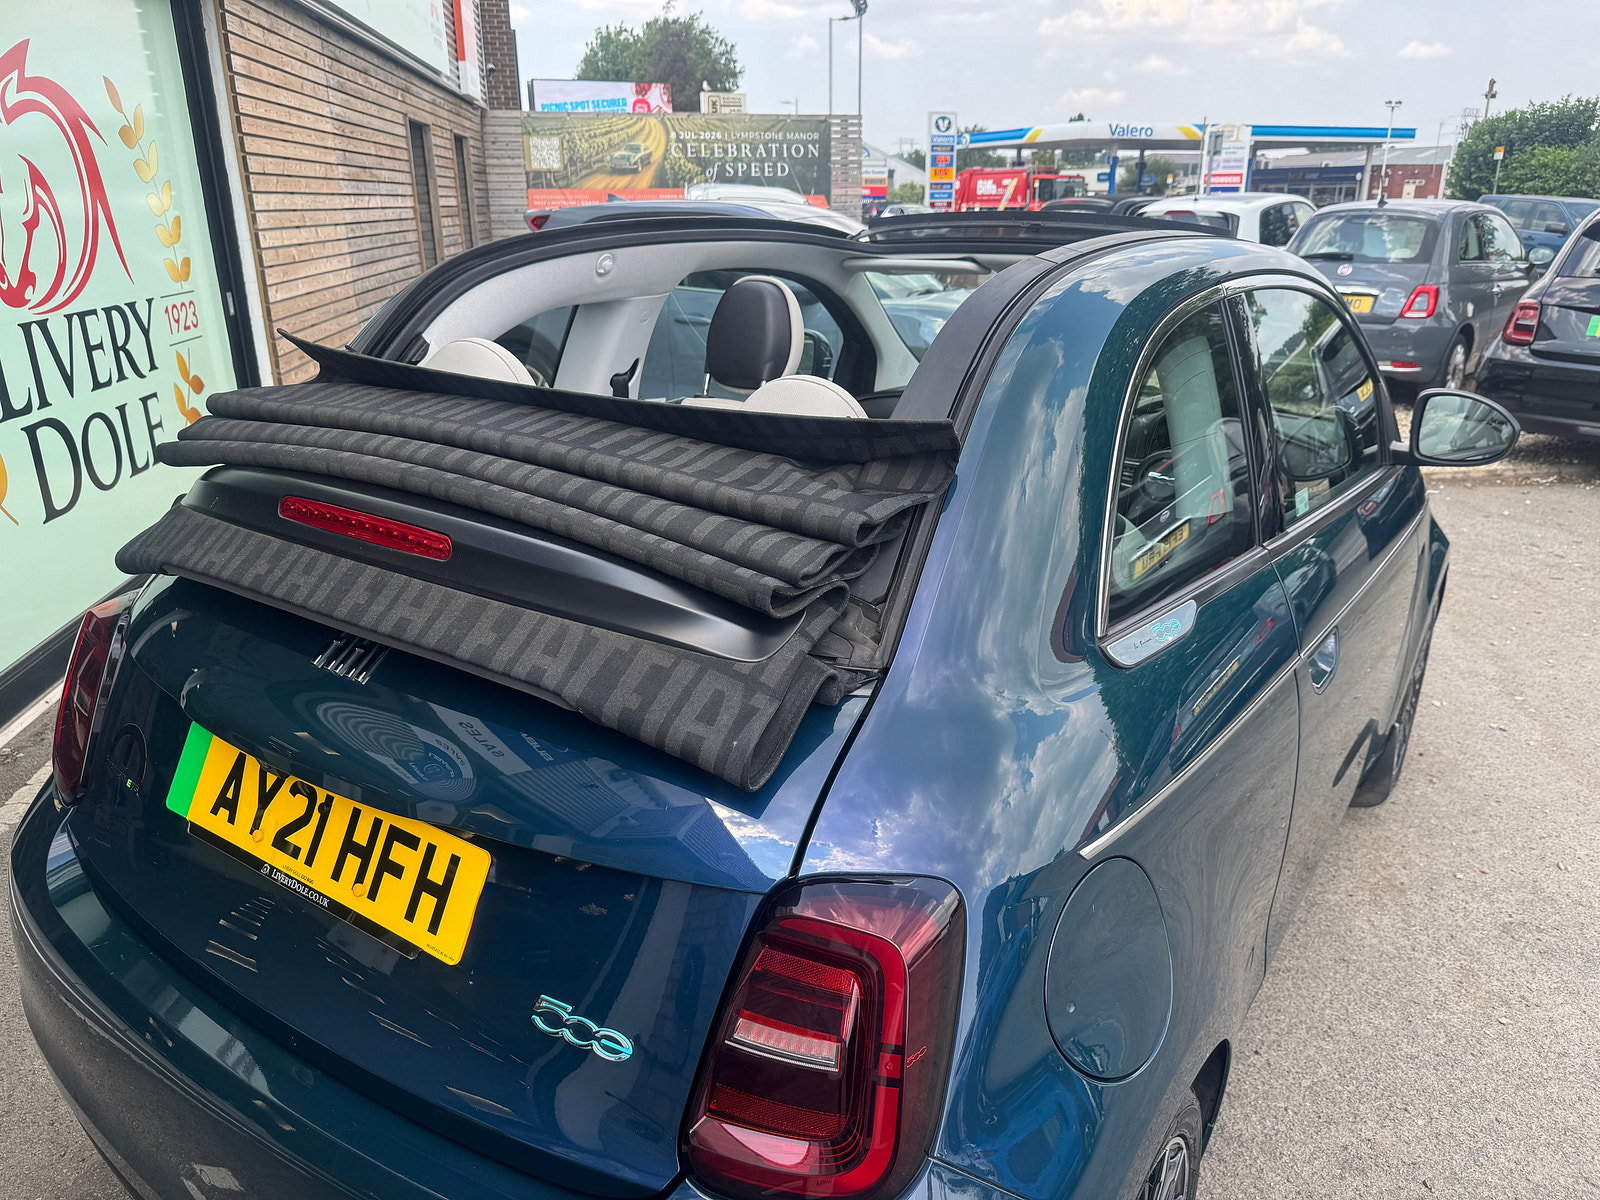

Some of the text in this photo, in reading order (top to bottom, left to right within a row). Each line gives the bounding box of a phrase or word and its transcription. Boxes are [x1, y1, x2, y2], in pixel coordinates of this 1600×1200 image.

[541, 98, 627, 112] PICNIC SPOT SECURED
[679, 131, 697, 139] JUL
[700, 131, 722, 139] 2026
[786, 132, 820, 140] MANOR
[1109, 123, 1153, 137] Valero
[670, 143, 820, 158] CELEBRATION
[705, 162, 790, 182] of SPEED
[164, 299, 200, 336] 1923
[0, 297, 160, 423] LIVERY
[20, 391, 165, 525] DOLE
[209, 752, 461, 936] AY21 HFH
[530, 994, 634, 1062] 500
